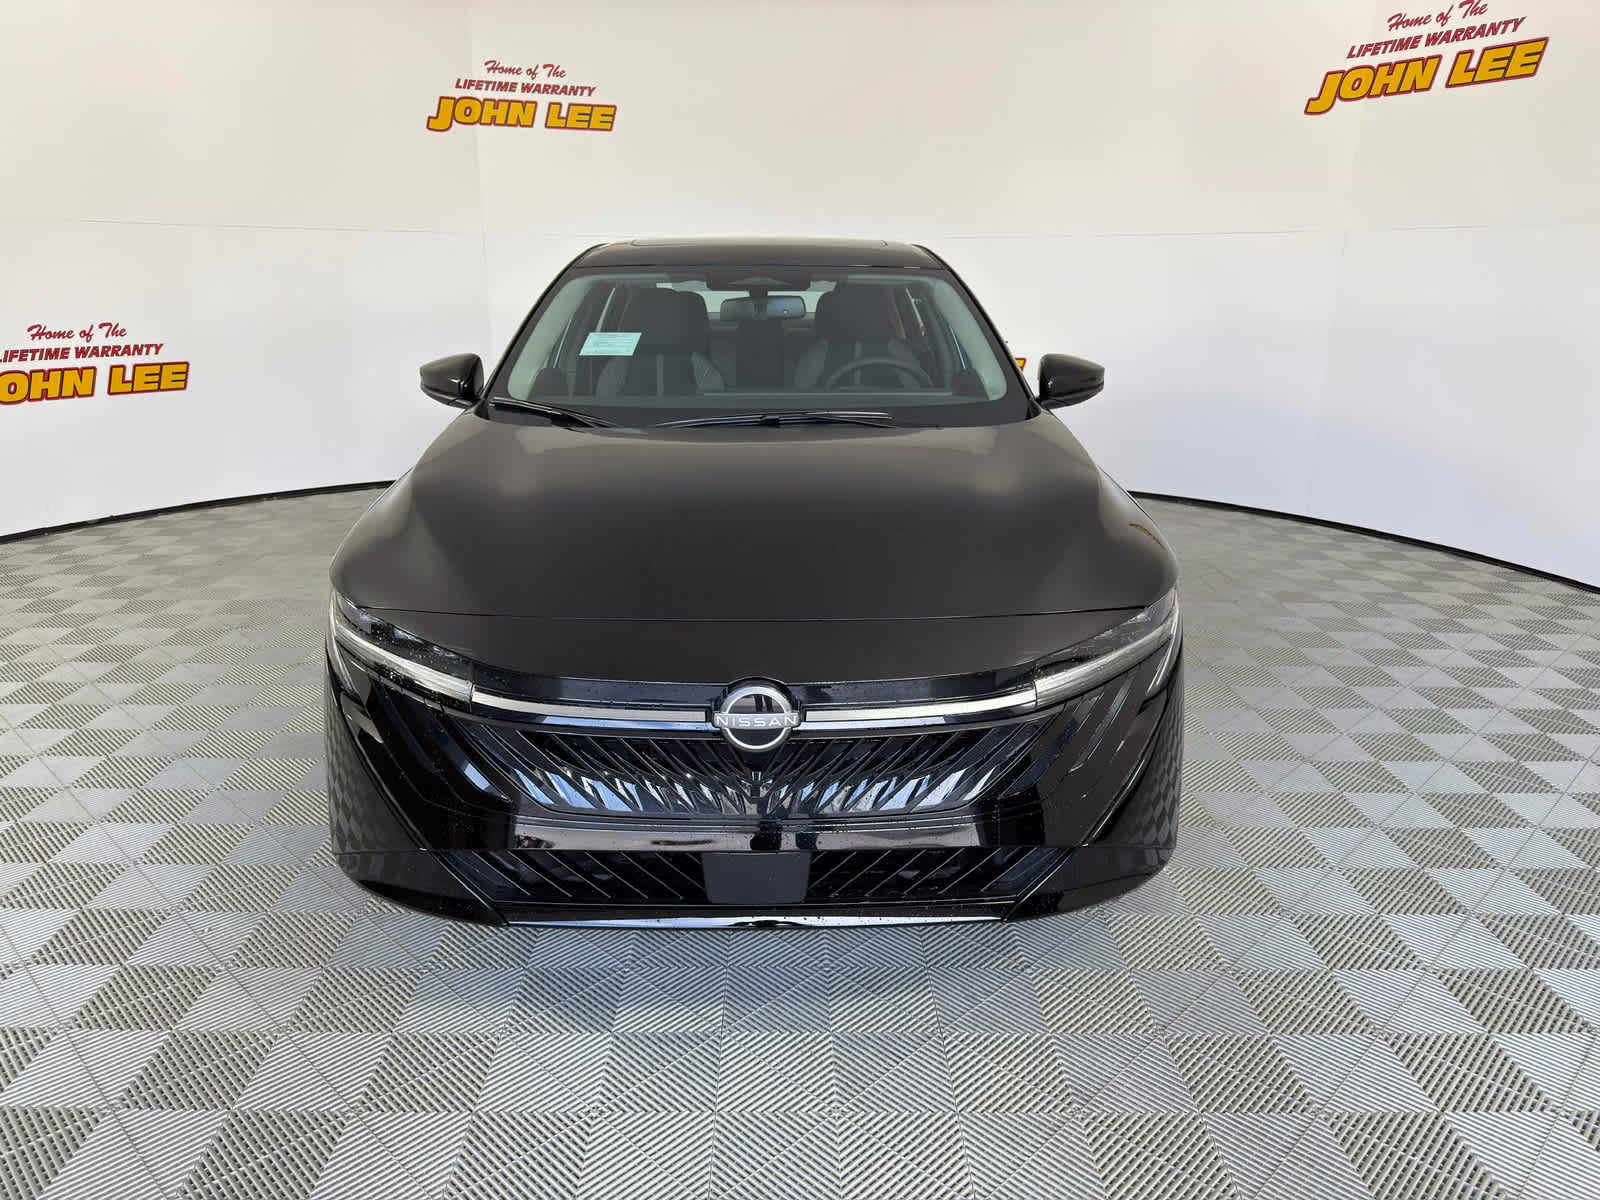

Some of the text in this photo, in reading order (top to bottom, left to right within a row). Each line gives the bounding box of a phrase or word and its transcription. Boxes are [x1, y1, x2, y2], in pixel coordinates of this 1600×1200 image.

[1387, 0, 1488, 31] Home of The
[1347, 16, 1526, 59] LIFETIME WARRANTY
[484, 60, 566, 80] Home of The
[1304, 37, 1549, 115] JOHN LEE
[455, 78, 596, 97] LIFETIME WARRANTY
[426, 96, 617, 132] JOHN LEE
[27, 322, 128, 343] Home of The
[0, 343, 164, 363] IFETIME WARRANTY
[0, 361, 190, 405] OHN LEE
[716, 715, 797, 727] NISSAN
